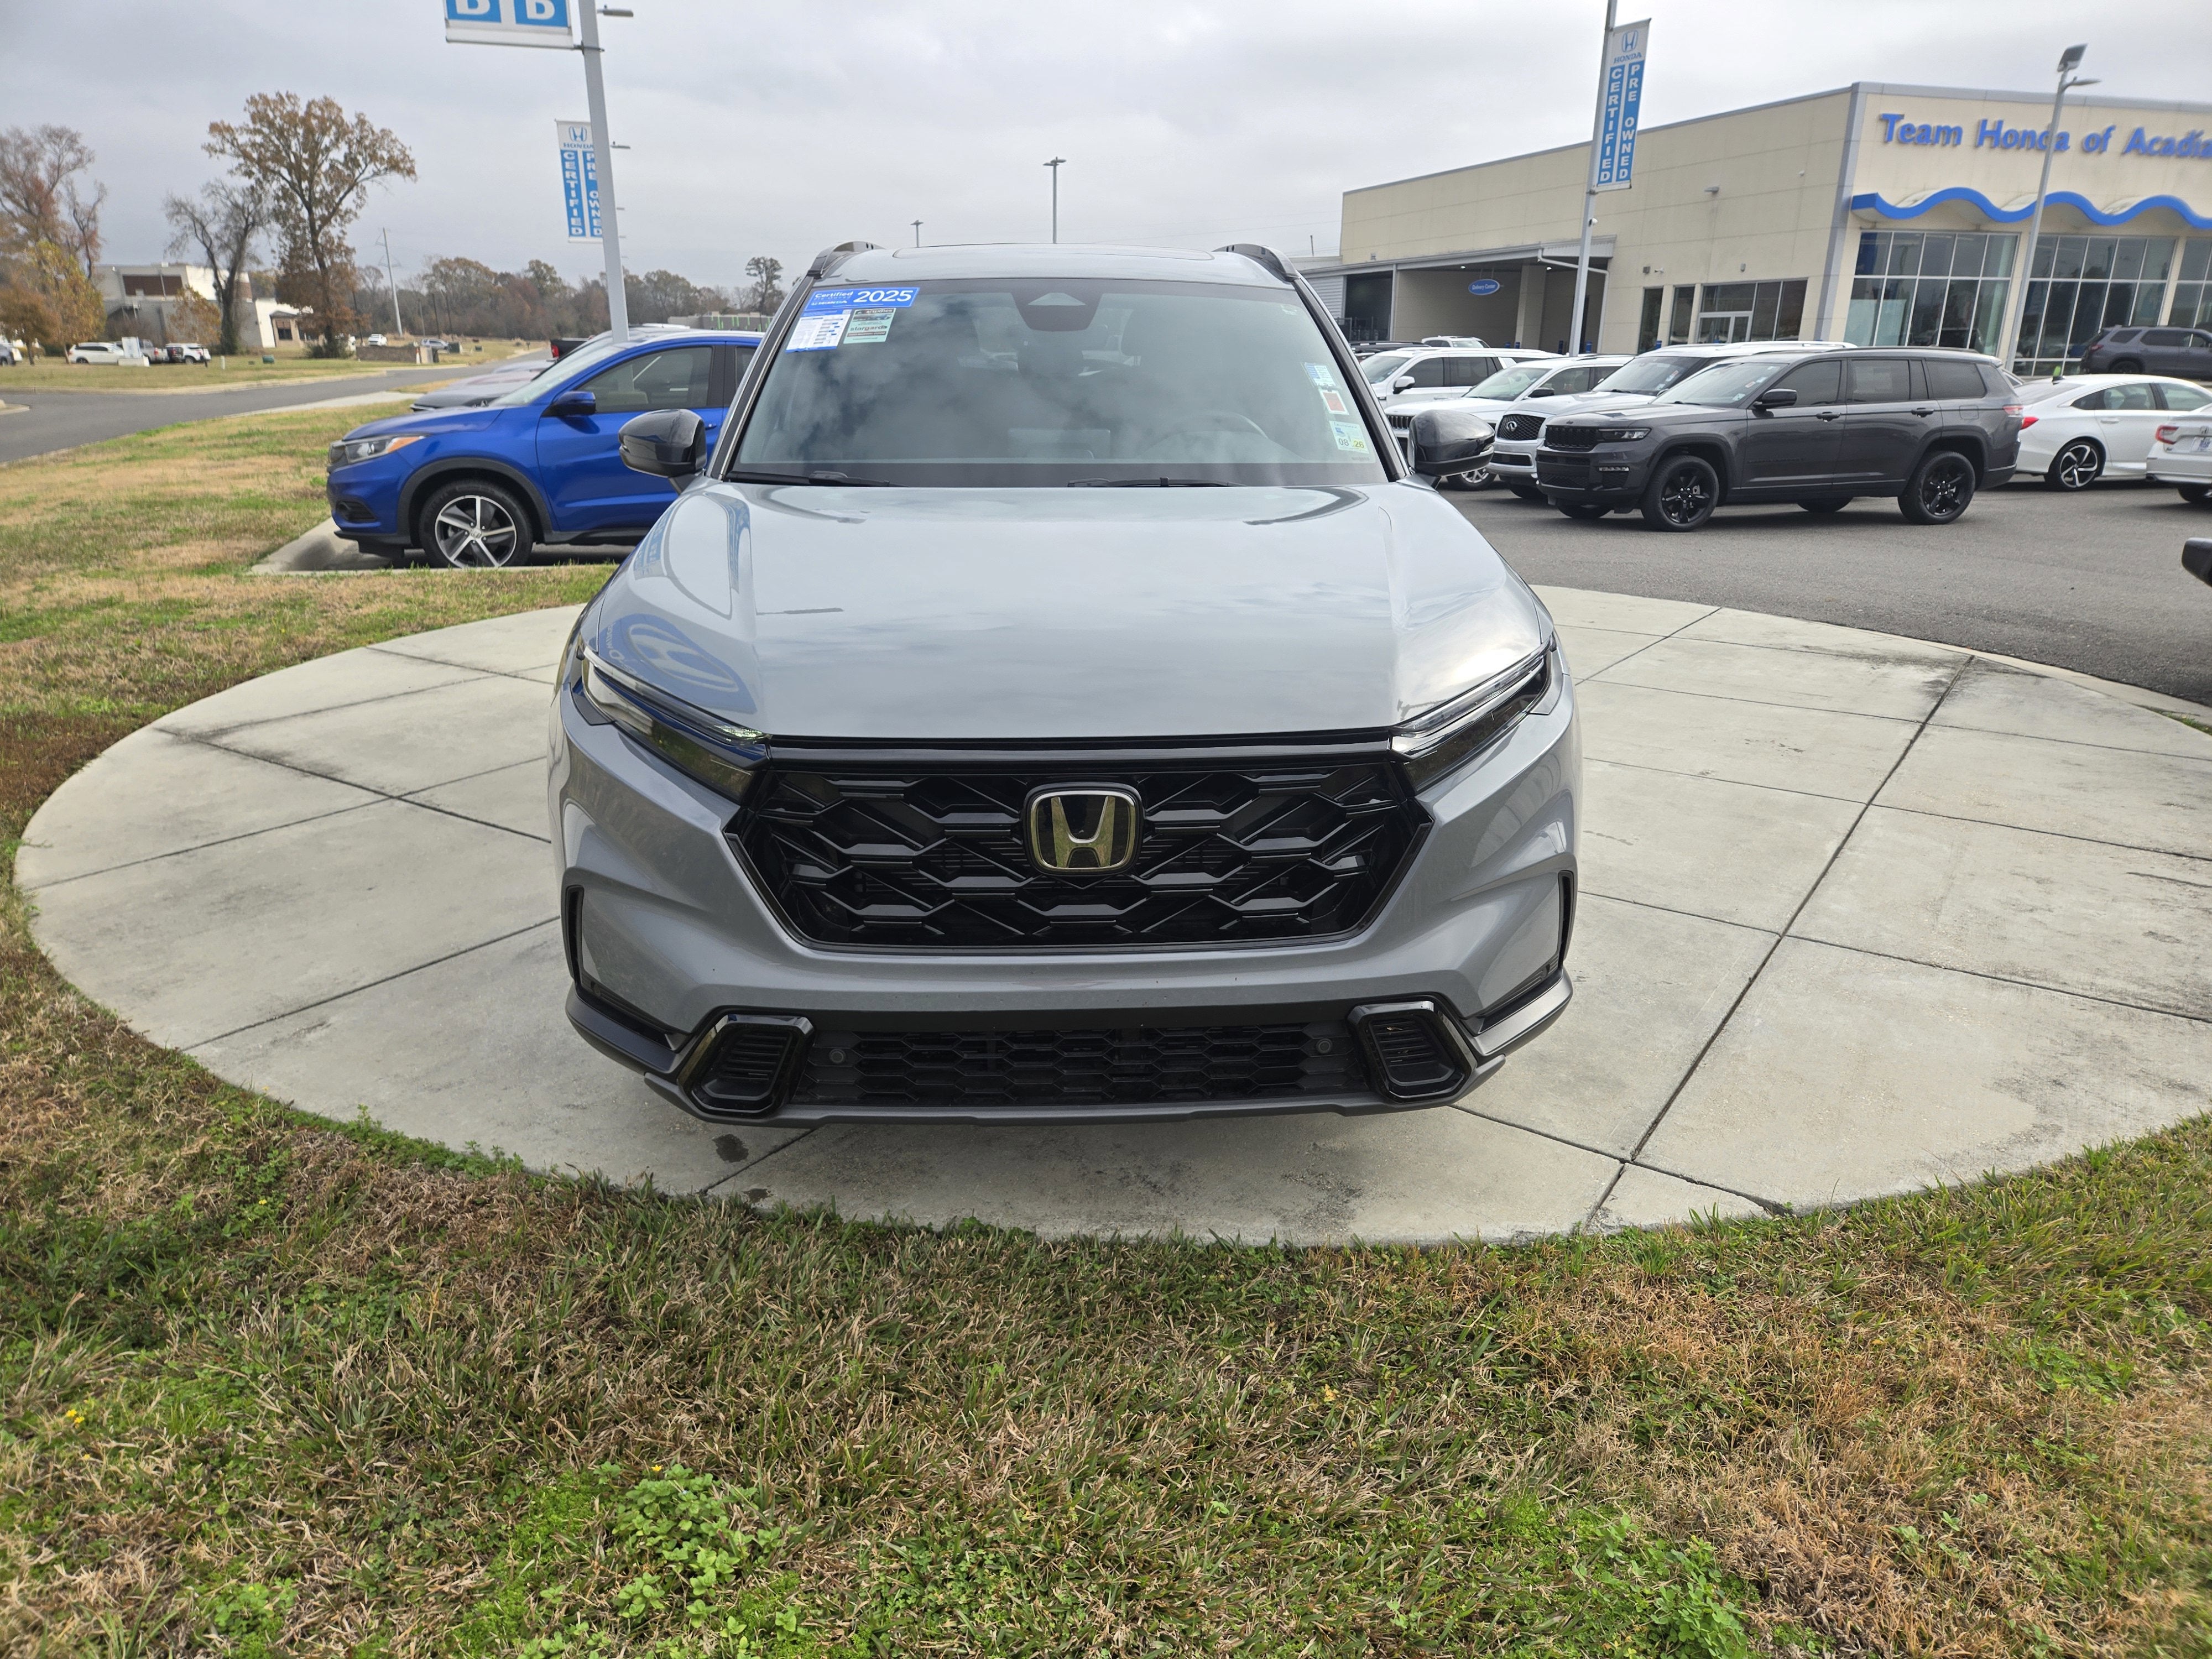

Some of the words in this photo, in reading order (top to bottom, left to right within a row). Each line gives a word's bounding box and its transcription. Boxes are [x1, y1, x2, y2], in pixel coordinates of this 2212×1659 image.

[1614, 52, 1642, 64] HONDA
[1628, 64, 1641, 102] PRE
[1600, 68, 1623, 182] CERTIFIED
[1880, 113, 1964, 145] Team
[2084, 124, 2116, 154] of
[1619, 117, 1635, 179] OWNED
[563, 152, 583, 236] CERTIFIED
[853, 290, 914, 303] 2025
[1338, 438, 1349, 446] 08
[1354, 440, 1365, 448] 26
